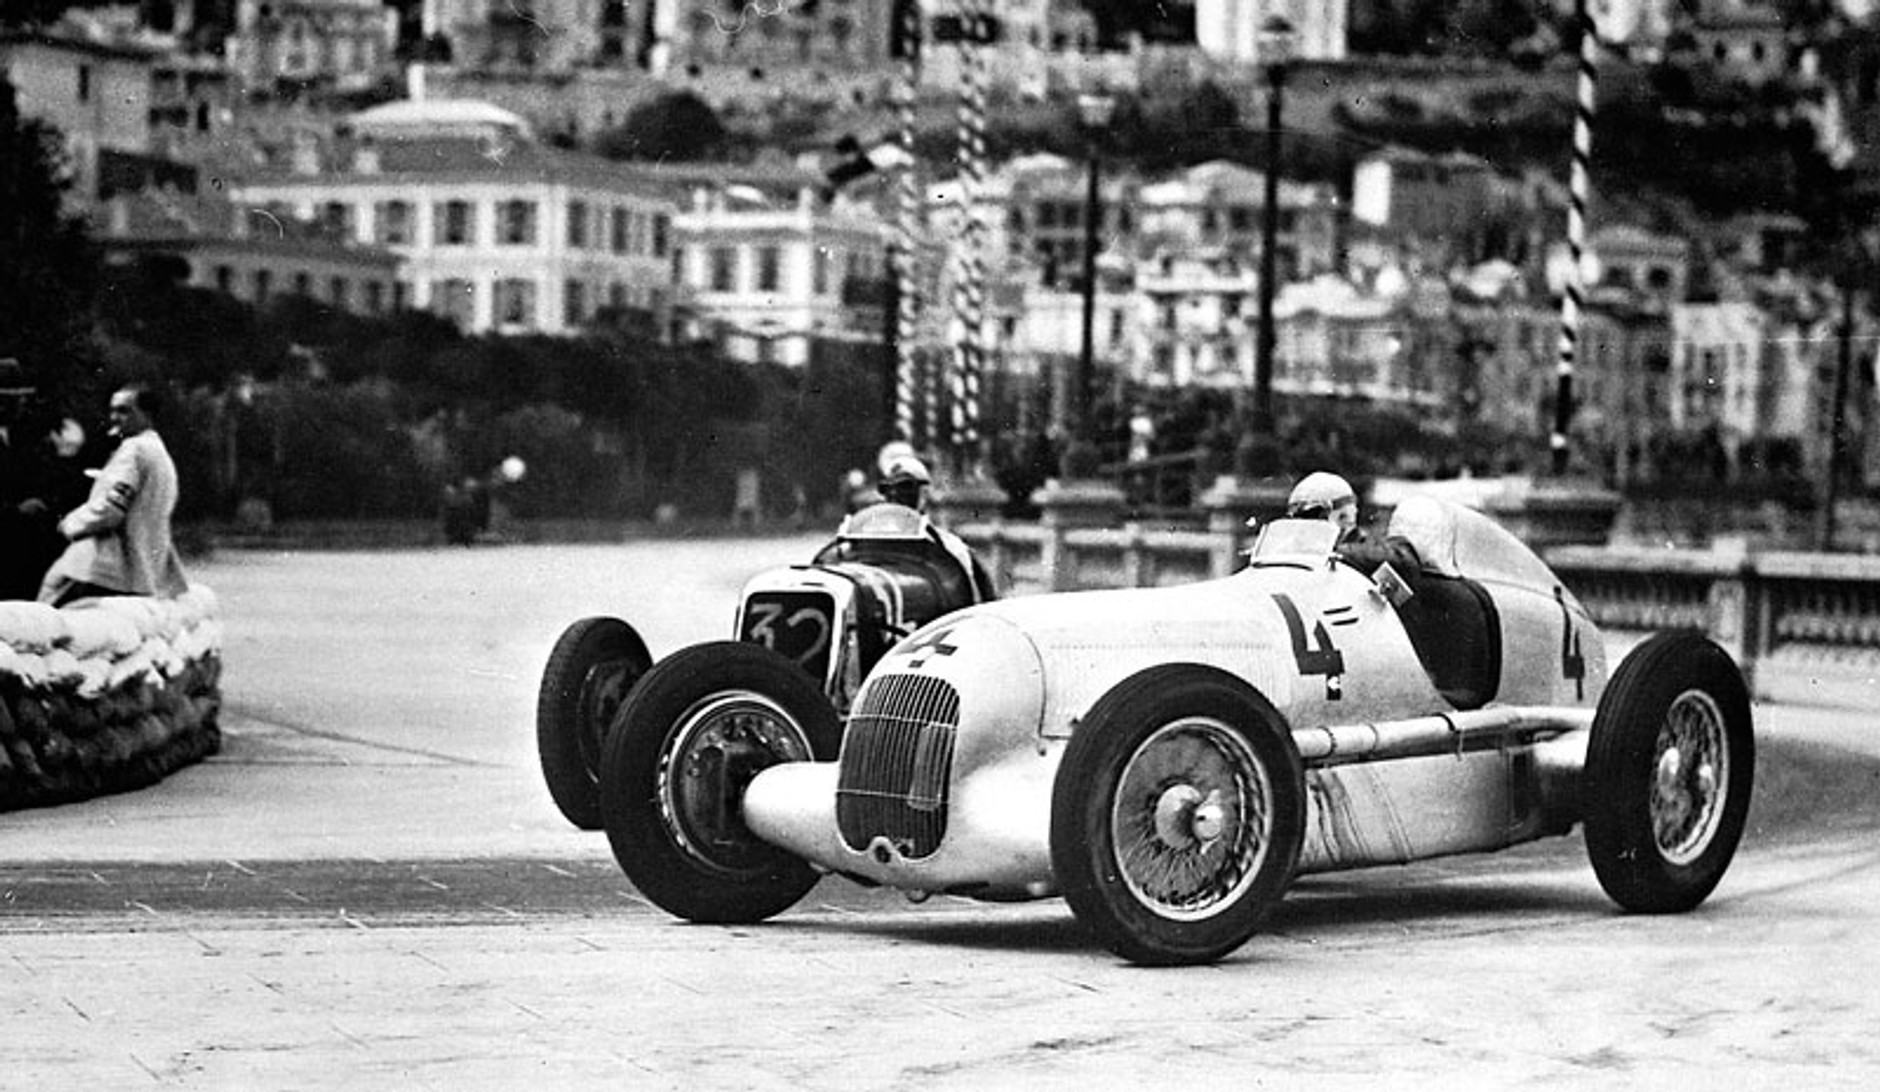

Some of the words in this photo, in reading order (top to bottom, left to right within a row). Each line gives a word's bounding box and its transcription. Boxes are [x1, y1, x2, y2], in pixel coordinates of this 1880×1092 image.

[750, 603, 830, 662] 32
[1271, 593, 1345, 700] 4
[1554, 585, 1585, 701] 4
